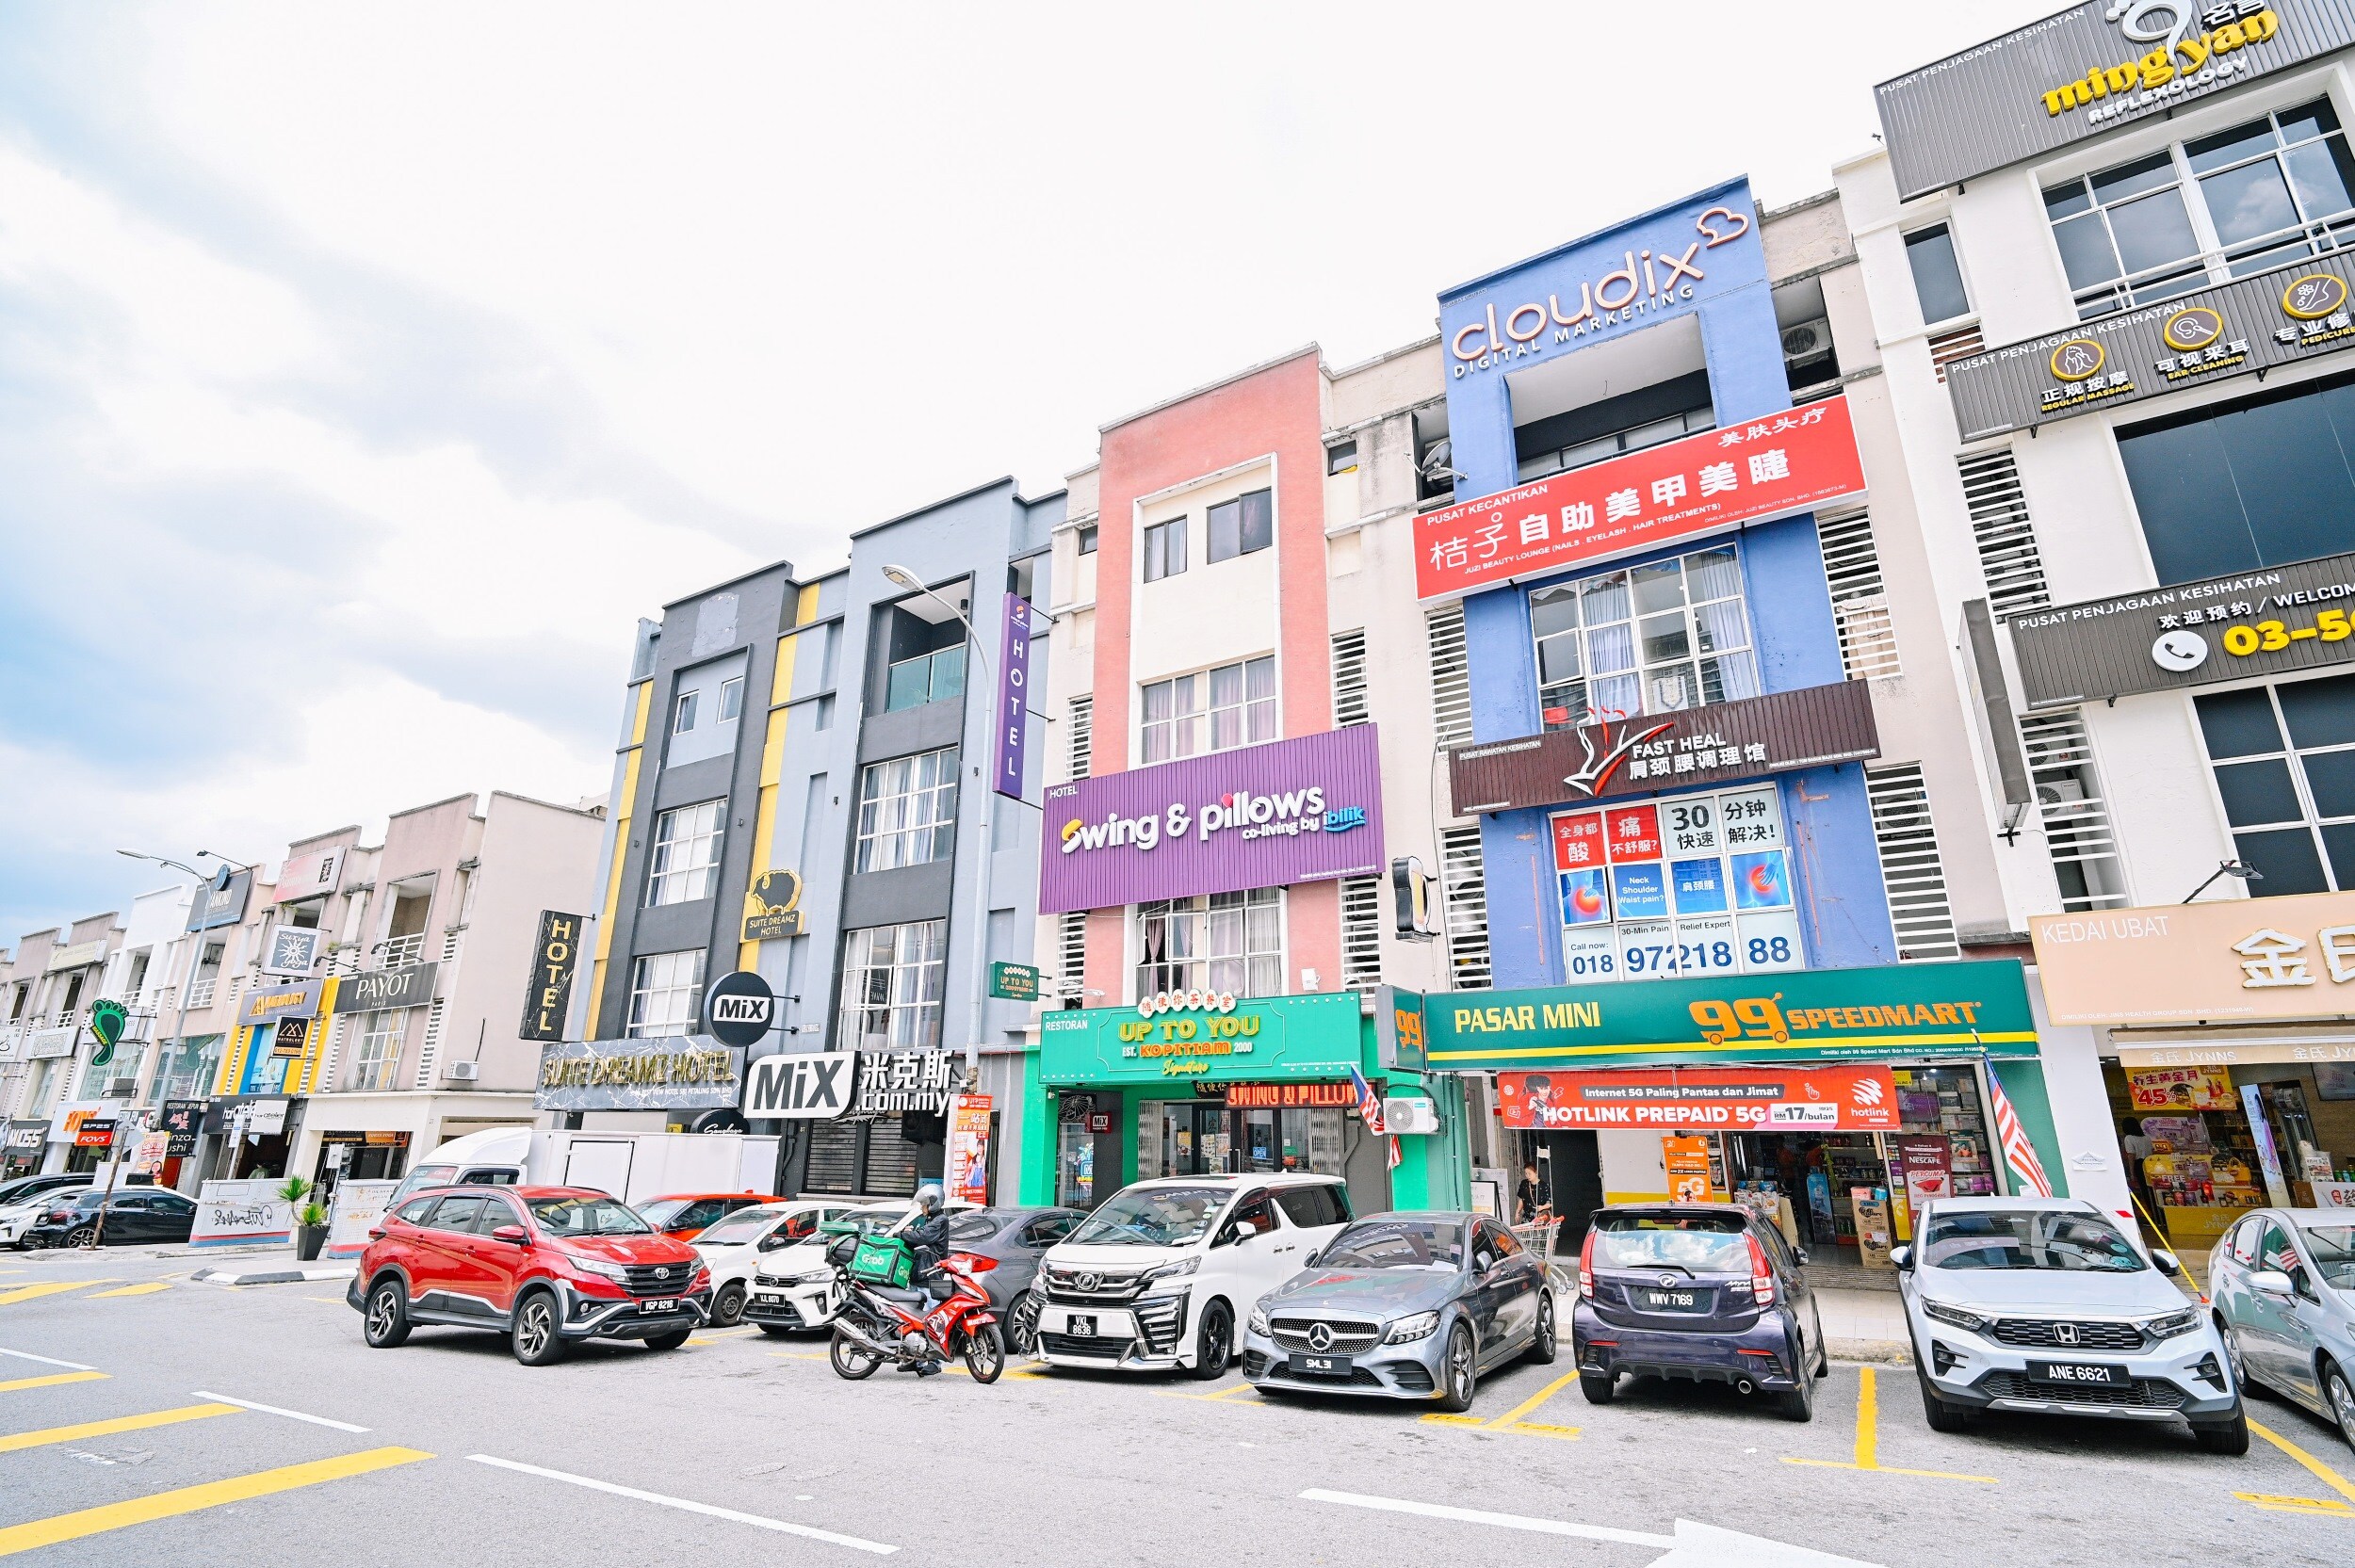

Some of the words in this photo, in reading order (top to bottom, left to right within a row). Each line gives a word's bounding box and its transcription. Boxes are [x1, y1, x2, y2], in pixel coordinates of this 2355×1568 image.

[1879, 74, 1918, 96] PUSAT
[1922, 40, 2003, 77] PENJAGAAN
[2006, 8, 2085, 44] KESIHATAN
[2087, 56, 2248, 124] REFLEXOLOGY
[1452, 241, 1704, 362] cloudix
[1454, 340, 1542, 380] DIGITAL
[1553, 283, 1695, 343] MARKETING
[1952, 355, 1996, 374] PUSAT
[2001, 330, 2093, 363] PENJAGAAN
[2096, 302, 2186, 337] KESIHATAN
[2275, 311, 2355, 343] 专业修
[2300, 325, 2355, 347] PEDICURE
[2155, 338, 2249, 373] 可视采耳
[2168, 368, 2189, 380] EAR
[2190, 355, 2245, 375] CLEANING
[2041, 370, 2130, 404] 正规按摩
[2041, 394, 2085, 412] REGULAR
[2087, 383, 2136, 402] MASSAGE
[1717, 406, 1827, 448] 美肤头疗
[1426, 503, 1466, 526] PUSAT
[1468, 484, 1548, 516] KECANTIKAN
[1519, 448, 1791, 545] 自助美甲美睫
[1759, 500, 1781, 510] BEAUTY
[1465, 564, 1482, 574] JUZI
[1483, 556, 1515, 570] BEAUTY
[1516, 546, 1550, 561] LOUNGE
[1552, 539, 1580, 554] (NAILS
[1586, 527, 1627, 543] EYELASH
[1632, 519, 1654, 531] HAIR
[1656, 503, 1721, 525] TREATMENTS)
[2019, 612, 2067, 630] PUSAT
[2071, 592, 2175, 621] PENJAGAAN
[2180, 573, 2281, 603] KESIHATAN
[2158, 600, 2251, 630] 欢迎预约
[1007, 637, 1025, 777] HOTEL
[1459, 752, 1479, 760] PUSAT
[1479, 747, 1506, 756] RAWATAN
[1507, 740, 1541, 752] KESIHATAN
[1632, 739, 1676, 758] FAST
[1681, 733, 1727, 752] HEAL
[1630, 742, 1767, 781] 肩颈腰调理馆
[1049, 785, 1079, 800] HOTEL
[1061, 812, 1160, 854] Swing
[1166, 803, 1192, 838] &
[1200, 785, 1326, 841] pillows
[1671, 805, 1710, 831] 30
[1725, 800, 1766, 821] 分钟
[1242, 820, 1299, 840] co-living
[1300, 816, 1320, 832] by
[1559, 822, 1599, 839] 全身都
[1618, 816, 1641, 837] 痛
[1728, 822, 1777, 843] 解决!
[1611, 839, 1658, 855] 不舒服?
[1677, 832, 1715, 849] 快速
[1567, 841, 1590, 863] 酸
[1618, 896, 1640, 904] Waist
[1643, 895, 1665, 904] pain?
[1622, 885, 1659, 895] Shoulder
[750, 918, 767, 929] SUITE
[769, 913, 796, 927] DREAMZ
[760, 926, 782, 935] HOTEL
[1621, 926, 1649, 936] 30-Min
[1650, 925, 1670, 933] Pain
[1681, 922, 1703, 931] Relief
[1704, 920, 1731, 930] Expert
[2041, 919, 2107, 945] KEDAI
[2111, 916, 2169, 940] UBAT
[1571, 943, 1587, 951] Call
[1589, 942, 1609, 950] now:
[1573, 954, 1614, 975] 018
[1627, 941, 1732, 974] 97218
[1748, 936, 1792, 964] 88
[355, 973, 414, 1000] PAYOT
[539, 919, 572, 1032] HOTEL
[1011, 978, 1019, 986] TO
[1022, 978, 1034, 987] YOU
[719, 997, 765, 1019] MiX
[1454, 1003, 1537, 1034] PASAR
[1541, 1001, 1601, 1028] MINI
[1688, 993, 1790, 1044] 99
[1786, 1001, 1979, 1030] SPEEDMART
[1045, 1020, 1089, 1031] RESTORAN
[1117, 1021, 1154, 1043] UP
[1159, 1018, 1197, 1041] TO
[1204, 1015, 1260, 1038] YOU
[1395, 1009, 1424, 1051] 99
[1122, 1046, 1138, 1058] EST.
[1140, 1042, 1232, 1058] KOPITIAM
[1234, 1042, 1254, 1053] 2000
[2151, 1051, 2182, 1064] 金氏
[2185, 1051, 2237, 1062] JYNNS
[2293, 1046, 2327, 1059] 金氏
[543, 1057, 591, 1085] SUITE
[671, 1050, 735, 1082] HOTEL
[861, 1050, 955, 1090] 米克斯
[1161, 1059, 1210, 1076] Signature
[754, 1059, 845, 1109] MiX
[1584, 1088, 1627, 1098] Internet
[1628, 1088, 1645, 1097] 5G
[1646, 1088, 1681, 1099] Paling
[1681, 1087, 1721, 1097] Pantas
[1722, 1087, 1744, 1096] dan
[1746, 1086, 1779, 1097] Jimat
[855, 1091, 951, 1117] .com.my
[2137, 1087, 2178, 1107] 45%
[1094, 1116, 1108, 1125] MiX
[1542, 1106, 1631, 1123] HOTLINK
[1735, 1106, 1767, 1123] 5G
[1850, 1107, 1891, 1118] hotlink
[1254, 1149, 1266, 1157] OPEN
[2162, 1174, 2186, 1183] FREE
[862, 1253, 885, 1266] Grab
[644, 1301, 658, 1310] VGP
[1648, 1292, 1668, 1305] WWV
[1670, 1293, 1694, 1306] 7169
[1075, 1315, 1089, 1326] VKL
[1306, 1359, 1323, 1369] SML
[2049, 1365, 2075, 1381] ANE
[2076, 1366, 2111, 1382] 6621
